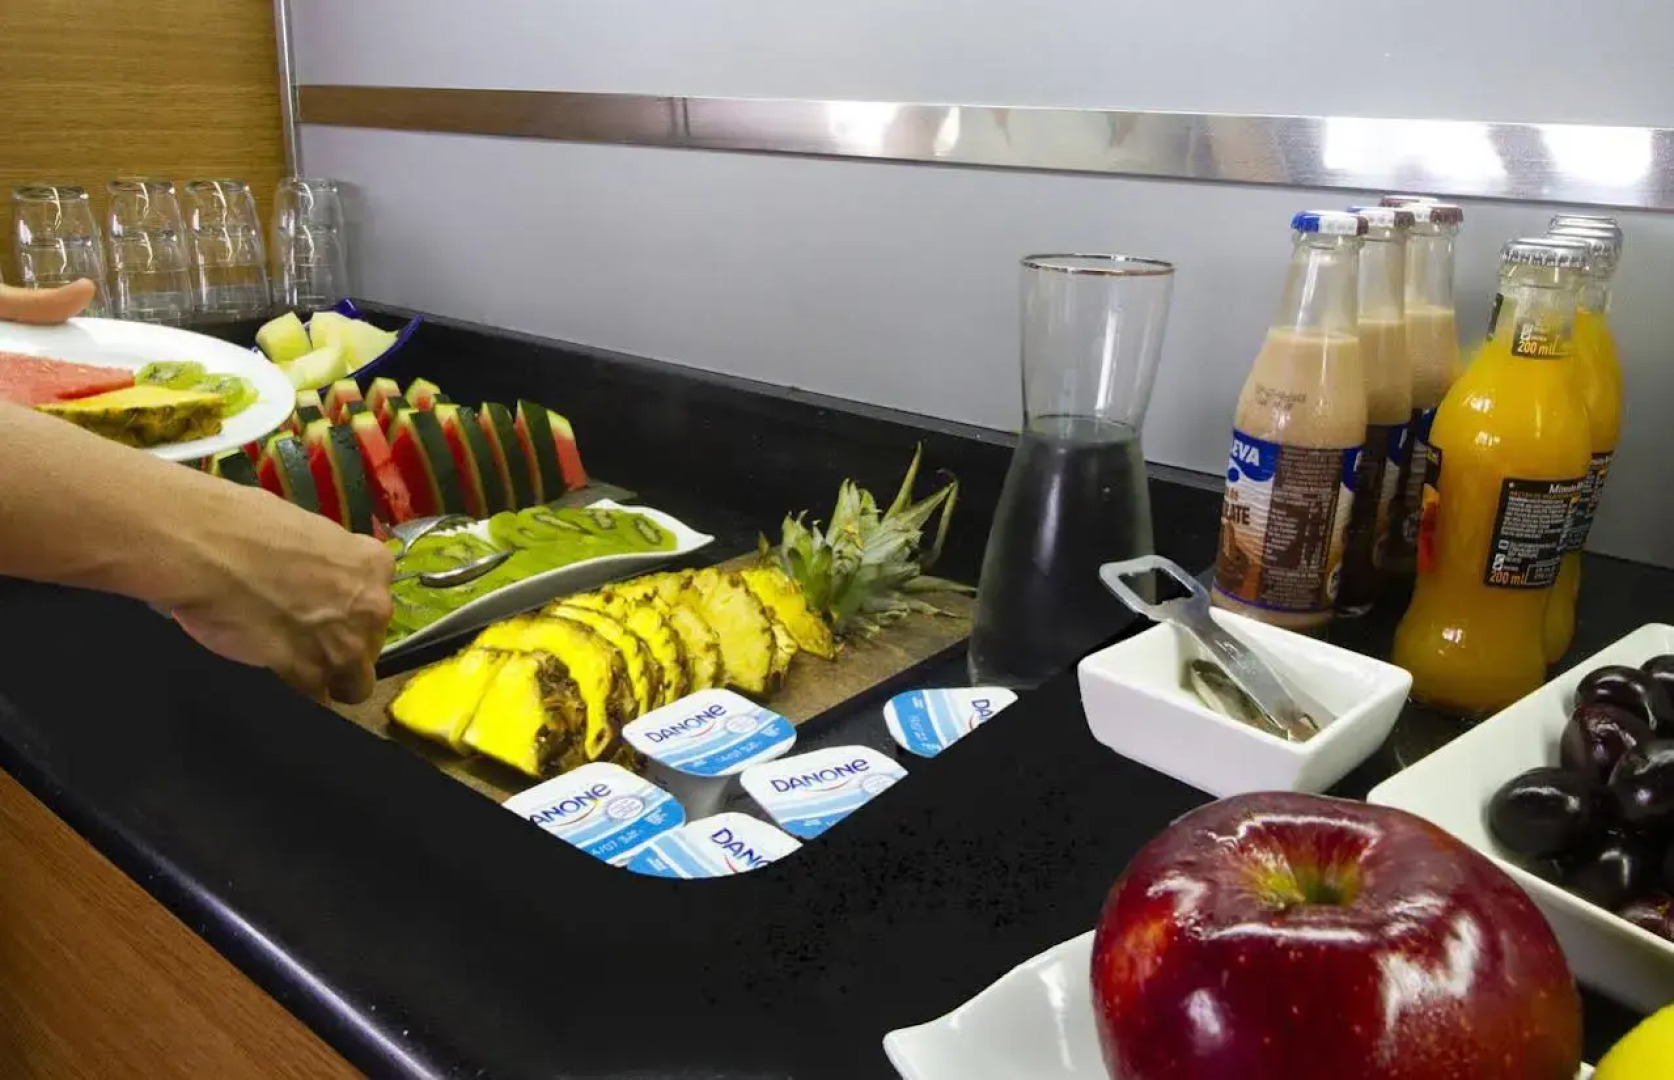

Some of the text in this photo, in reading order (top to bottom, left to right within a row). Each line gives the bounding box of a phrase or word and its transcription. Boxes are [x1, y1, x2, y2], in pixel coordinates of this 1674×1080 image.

[1517, 340, 1537, 354] 200
[1489, 570, 1509, 584] 200
[644, 703, 727, 743] DANONE
[770, 758, 870, 792] DANONE
